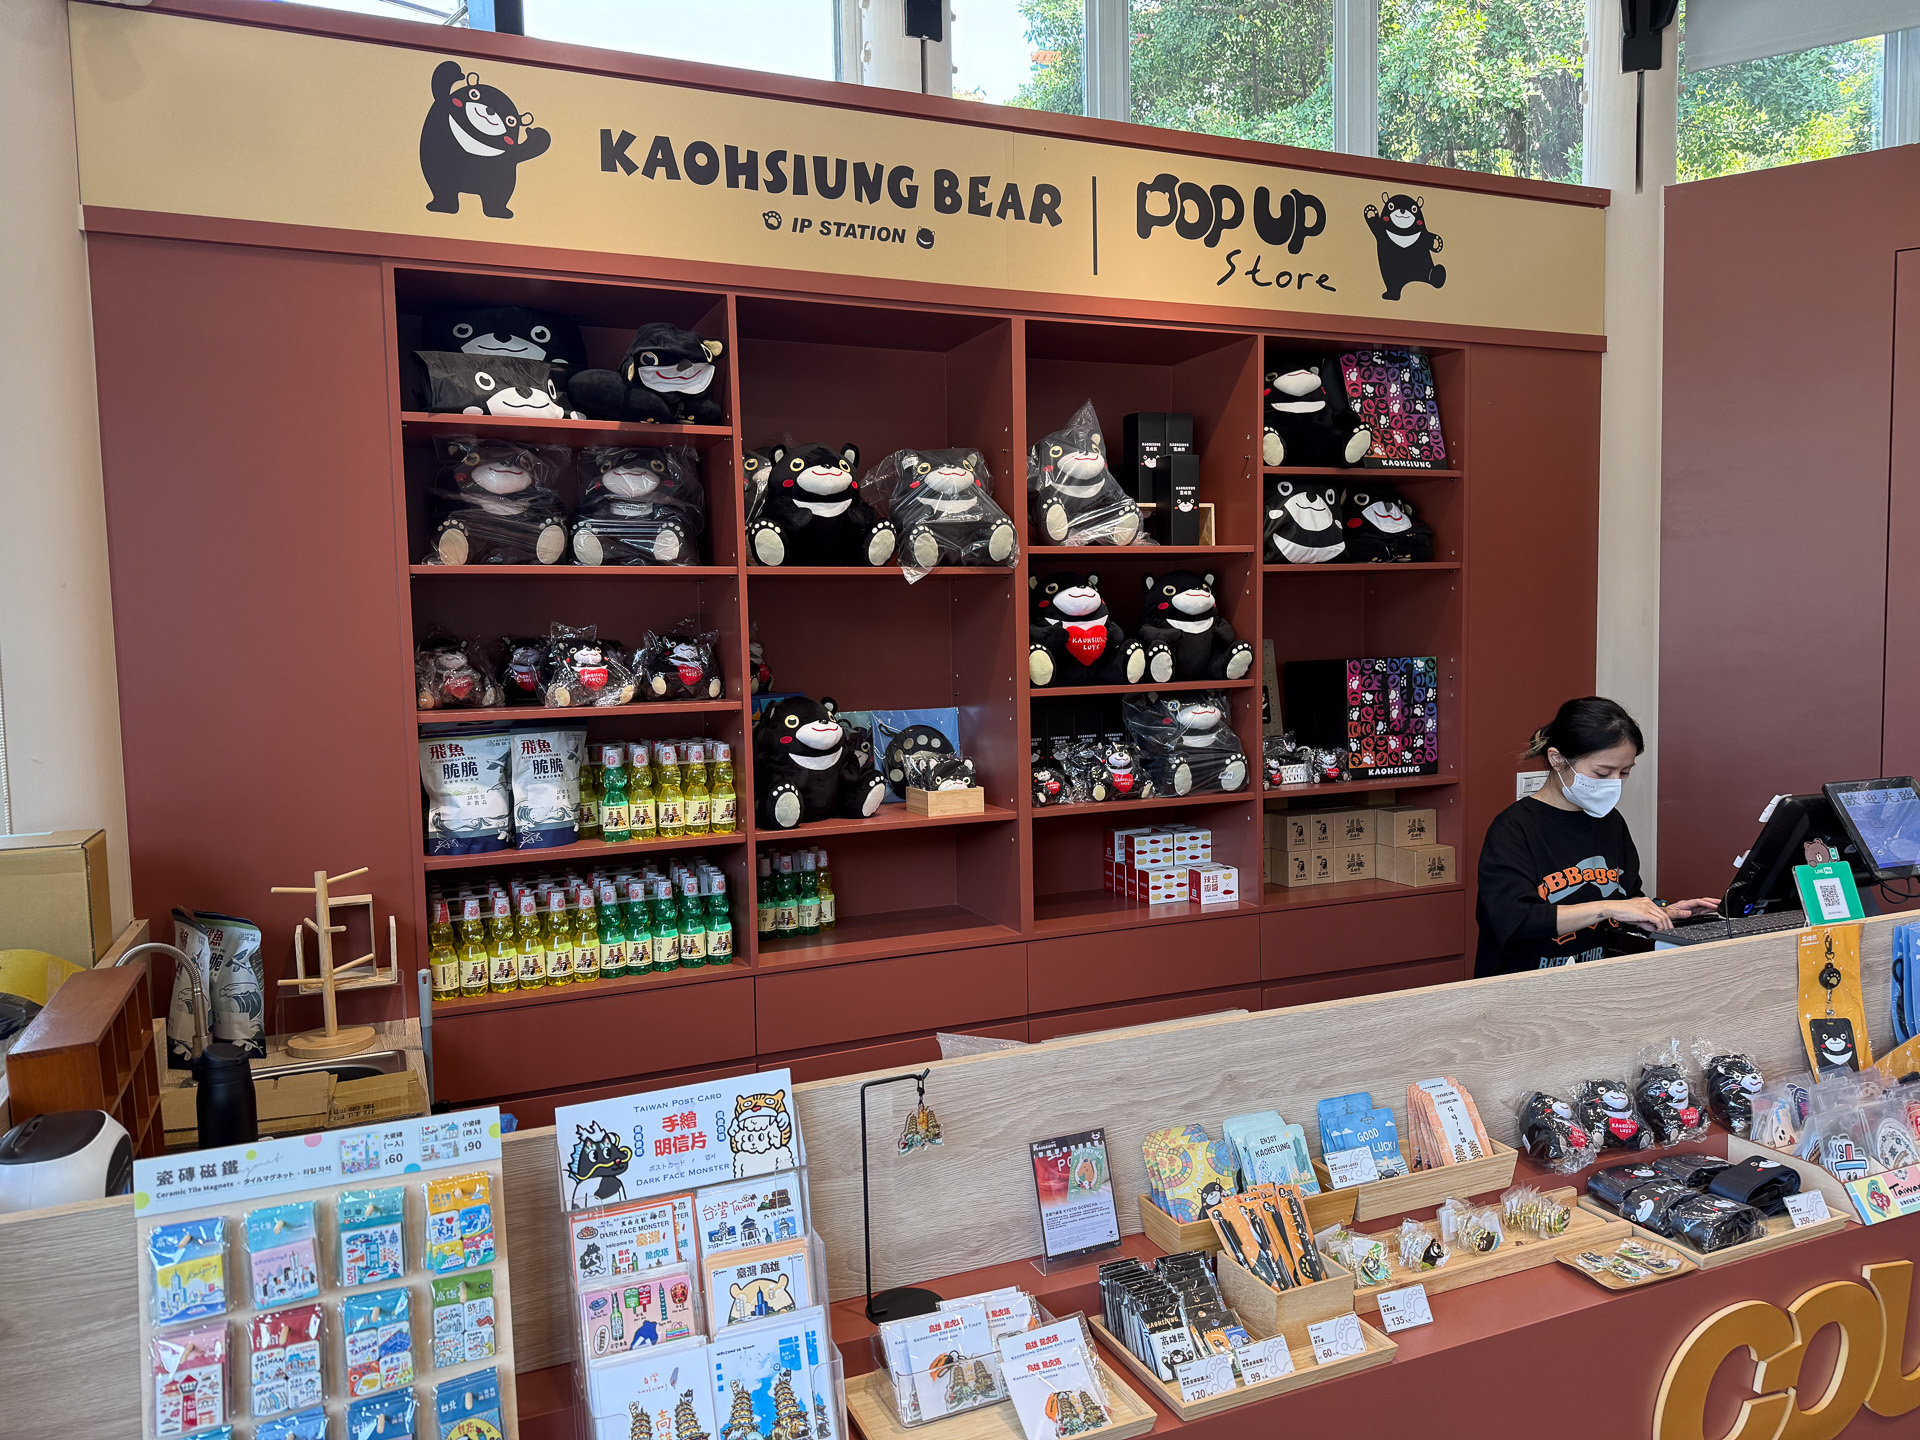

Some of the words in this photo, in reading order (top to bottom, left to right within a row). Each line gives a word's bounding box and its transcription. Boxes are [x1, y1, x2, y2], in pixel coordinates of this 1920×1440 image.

[600, 128, 919, 210] KAOHSIUNG
[934, 168, 1063, 228] BEAR
[1136, 173, 1245, 248] POP
[1253, 186, 1327, 255] UP
[792, 217, 813, 234] IP
[819, 219, 907, 244] STATION
[1216, 249, 1337, 292] Store
[1381, 459, 1432, 469] KAOHSIUNG
[428, 743, 466, 760] 飛魚
[520, 738, 553, 756] 飛魚
[442, 761, 479, 780] 脆脆
[532, 758, 564, 775] 脆脆
[1368, 766, 1421, 776] KAOHSIUNG
[633, 1101, 669, 1113] TAIWAN
[671, 1096, 695, 1107] POST
[697, 1092, 722, 1103] CARD
[661, 1111, 697, 1133] 手繪
[1259, 1134, 1277, 1145] ENJOY
[1356, 1127, 1379, 1143] GOOD
[464, 1140, 482, 1153] $90
[654, 1130, 708, 1157] 明信片
[1255, 1142, 1292, 1158] KAOHSIUNG
[1373, 1141, 1397, 1153] LUCK!
[384, 1153, 403, 1165] $60
[649, 1160, 685, 1172] ポストカード
[156, 1159, 240, 1187] 瓷磚磁鐵
[243, 1172, 295, 1186] タイルマグネット
[636, 1176, 661, 1187] DARK
[663, 1171, 686, 1181] FACE
[688, 1163, 730, 1176] MONSTER
[1339, 1174, 1348, 1183] 89
[1175, 1186, 1193, 1198] HAVE
[1192, 1182, 1198, 1190] A
[1195, 1164, 1205, 1183] NICE
[156, 1188, 187, 1199] Ceramic
[188, 1186, 202, 1195] Tile
[203, 1181, 235, 1193] Magnets
[703, 1201, 729, 1221] 台灣
[729, 1200, 756, 1215] Taiwan
[437, 1225, 454, 1237] KH
[599, 1230, 619, 1239] DARK
[619, 1226, 637, 1236] FACE
[638, 1220, 670, 1232] MONSTER
[605, 1240, 628, 1249] welcome
[760, 1260, 781, 1275] 高雄
[346, 1266, 354, 1285] LOVE
[991, 1307, 1011, 1318] 龍虎塔
[928, 1321, 942, 1334] 高雄
[1391, 1315, 1405, 1326] 135
[913, 1333, 939, 1343] KAOHSIUNG
[968, 1321, 982, 1329] TIGER
[1160, 1332, 1187, 1346] 高雄熊
[1024, 1340, 1039, 1351] 高雄
[1039, 1334, 1060, 1346] 龍虎塔
[1011, 1349, 1036, 1360] KAOHSIUNG
[1036, 1345, 1054, 1353] DRAGON
[1322, 1348, 1333, 1359] 60
[255, 1356, 286, 1370] TAINAN
[1026, 1362, 1041, 1373] 高雄
[1041, 1357, 1062, 1369] 龍虎塔
[1039, 1367, 1057, 1375] DRAGON
[1067, 1361, 1080, 1369] TIGER
[1250, 1372, 1261, 1383] 99
[1191, 1388, 1206, 1401] 120
